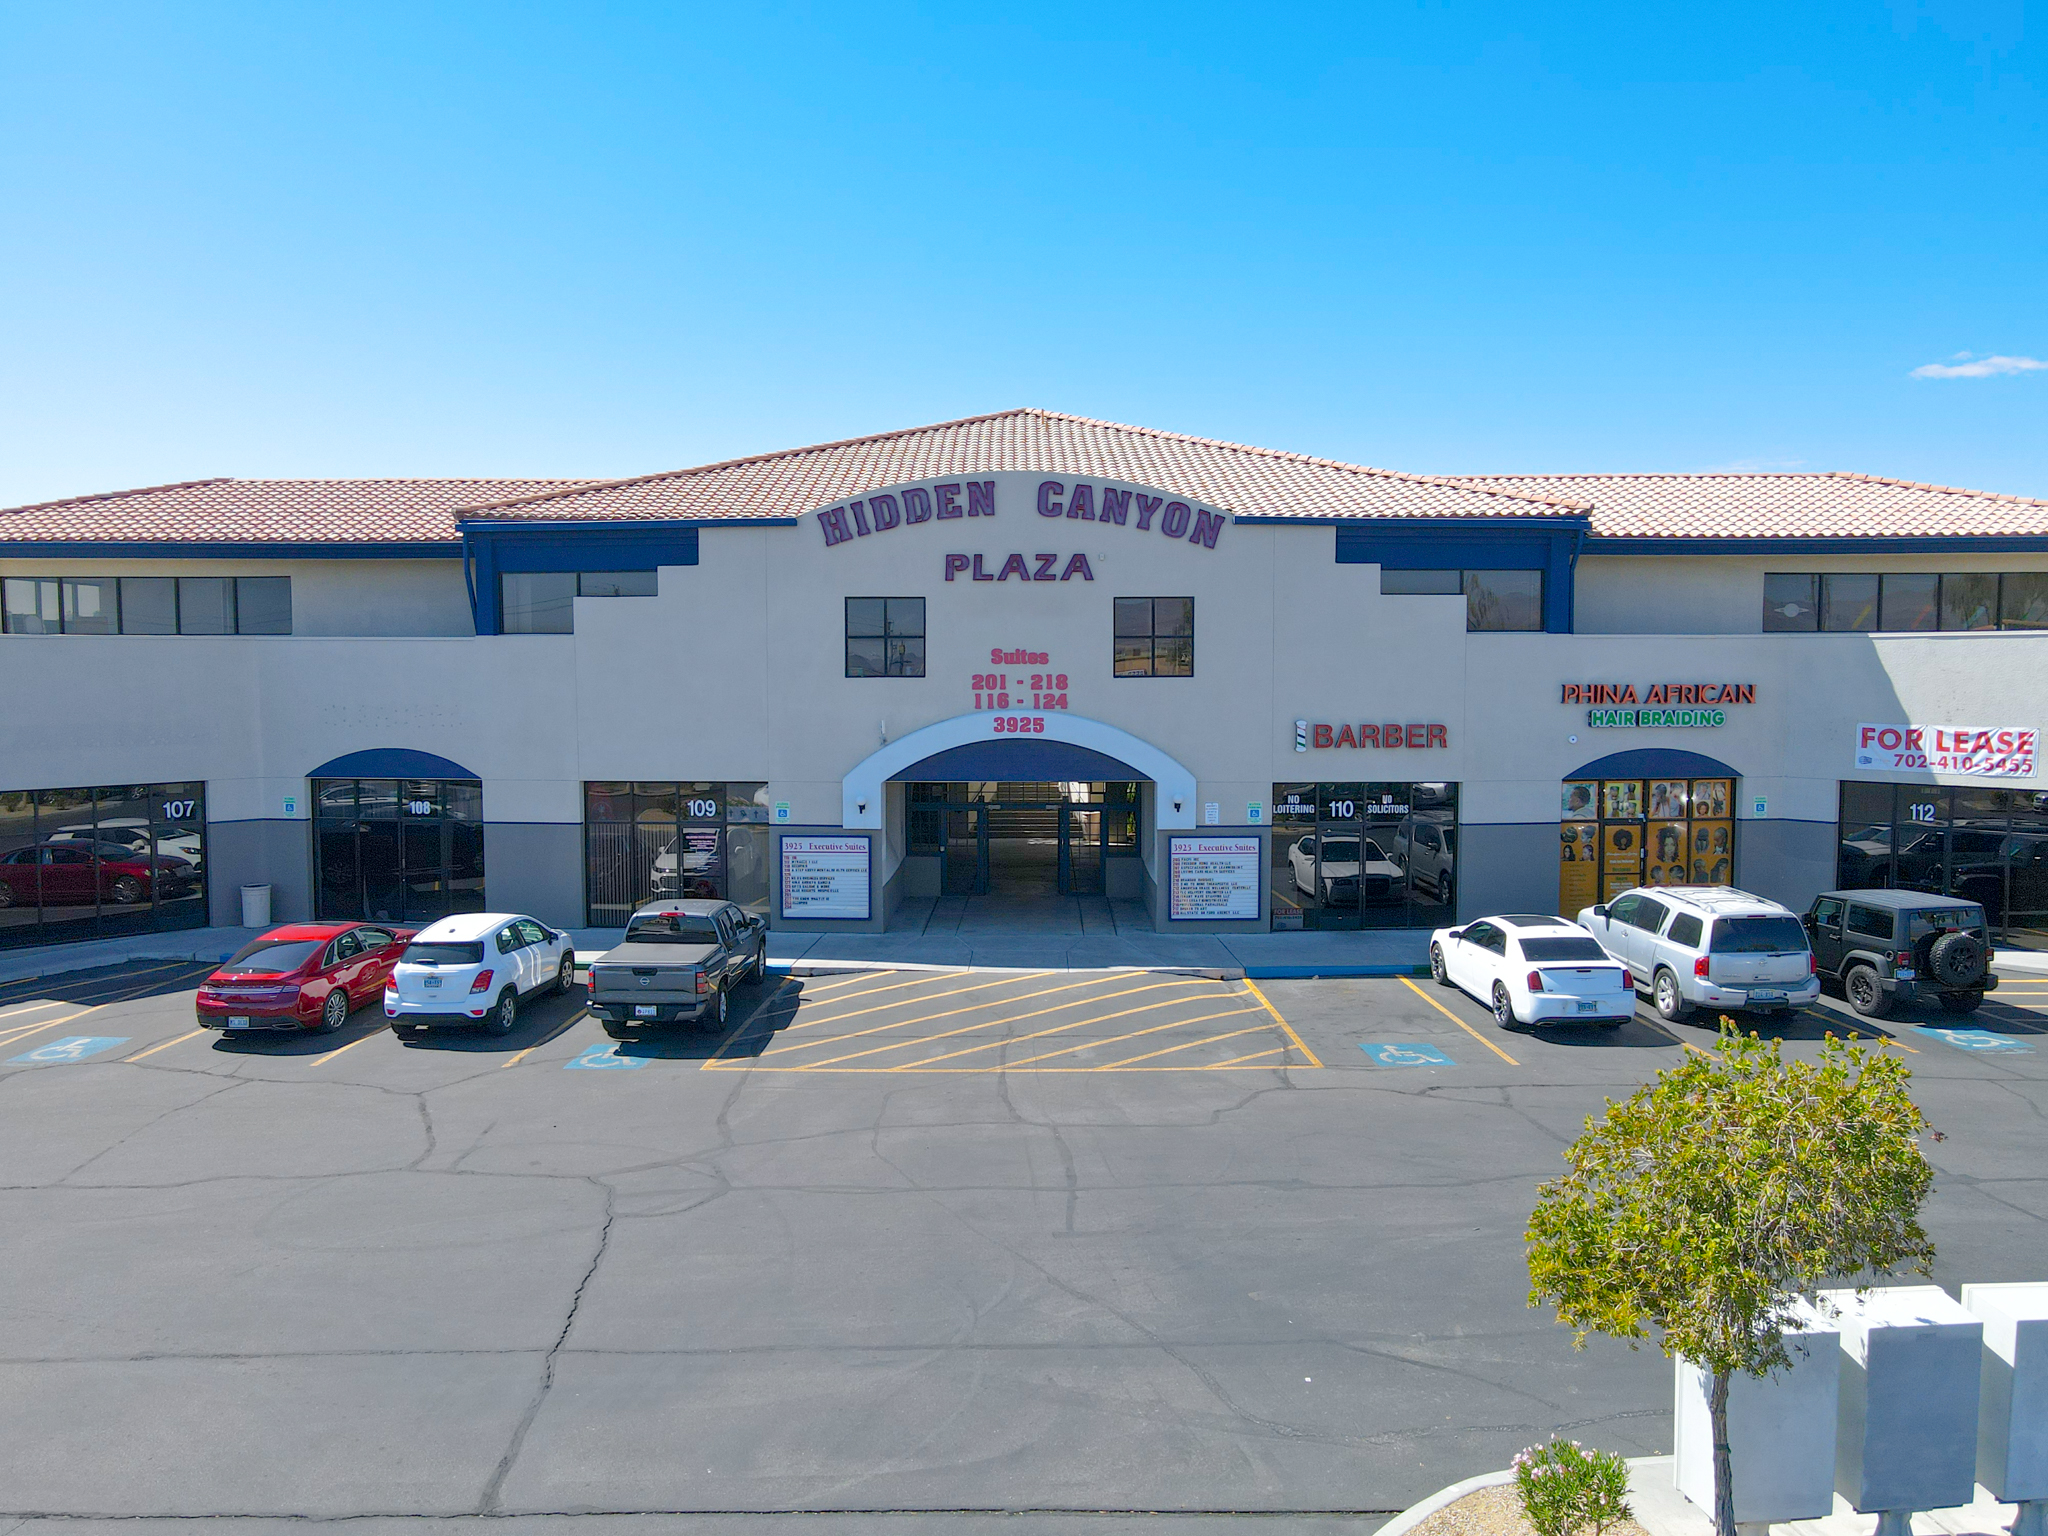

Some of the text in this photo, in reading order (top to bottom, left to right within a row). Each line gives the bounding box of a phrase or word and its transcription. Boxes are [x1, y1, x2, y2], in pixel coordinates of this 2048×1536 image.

[817, 480, 1226, 549] HIDDEN CANYON
[945, 553, 1094, 581] PLAZA
[991, 648, 1049, 665] Suites
[972, 674, 1006, 690] 201
[1030, 674, 1068, 690] 218
[974, 692, 1009, 709] 116
[1033, 693, 1068, 709] 124
[1561, 684, 1757, 704] PHINA AFRICAN
[993, 716, 1044, 733] 3925
[1590, 710, 1725, 727] HAIR BRAIDING
[1313, 723, 1448, 749] BARBER
[1861, 727, 2035, 755] FOR LEASE
[1893, 753, 2033, 774] 702-410-5455
[410, 800, 431, 815] 108
[1287, 794, 1300, 804] NO
[1382, 794, 1393, 804] NO
[162, 800, 195, 819] 107
[687, 799, 717, 817] 109
[1273, 804, 1315, 814] LOITERING
[1328, 800, 1354, 818] 110
[1367, 804, 1409, 814] SOLICITORS
[1910, 803, 1935, 822] 112
[784, 842, 866, 850] 3925 Executive Suites
[1173, 843, 1256, 852] 3925 Executive Suites
